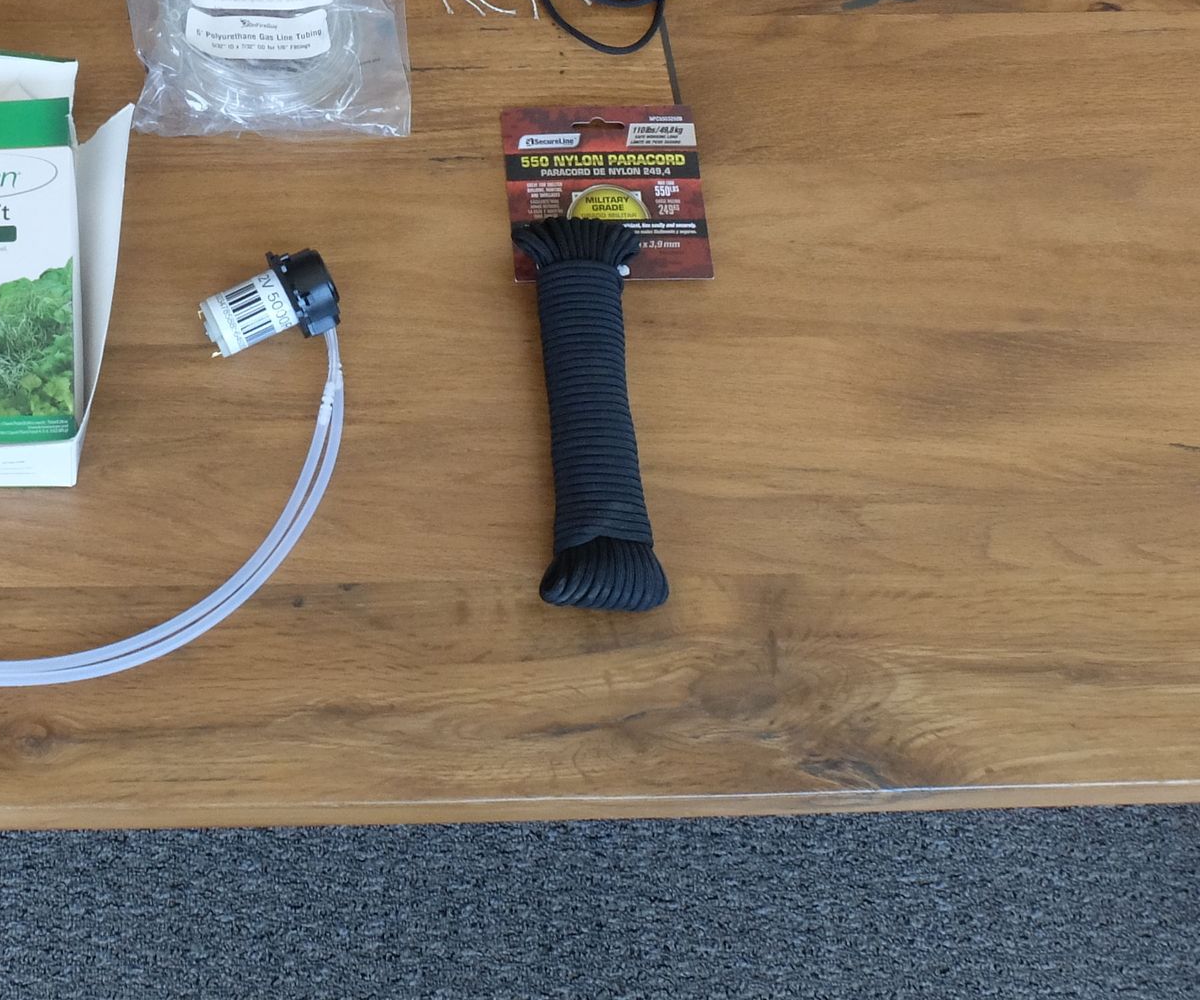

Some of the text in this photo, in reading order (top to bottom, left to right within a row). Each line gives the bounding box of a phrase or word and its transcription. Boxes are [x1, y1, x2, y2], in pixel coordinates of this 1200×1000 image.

[205, 31, 257, 41] Polyurethane
[259, 33, 274, 41] Gas
[276, 33, 293, 41] Line
[295, 29, 323, 41] Tubing
[520, 153, 686, 168] 550 NYLON PARACORD
[540, 167, 671, 177] PARACORD DE NYLON 249,4
[585, 196, 630, 204] MILITARY
[591, 204, 625, 212] GRADE
